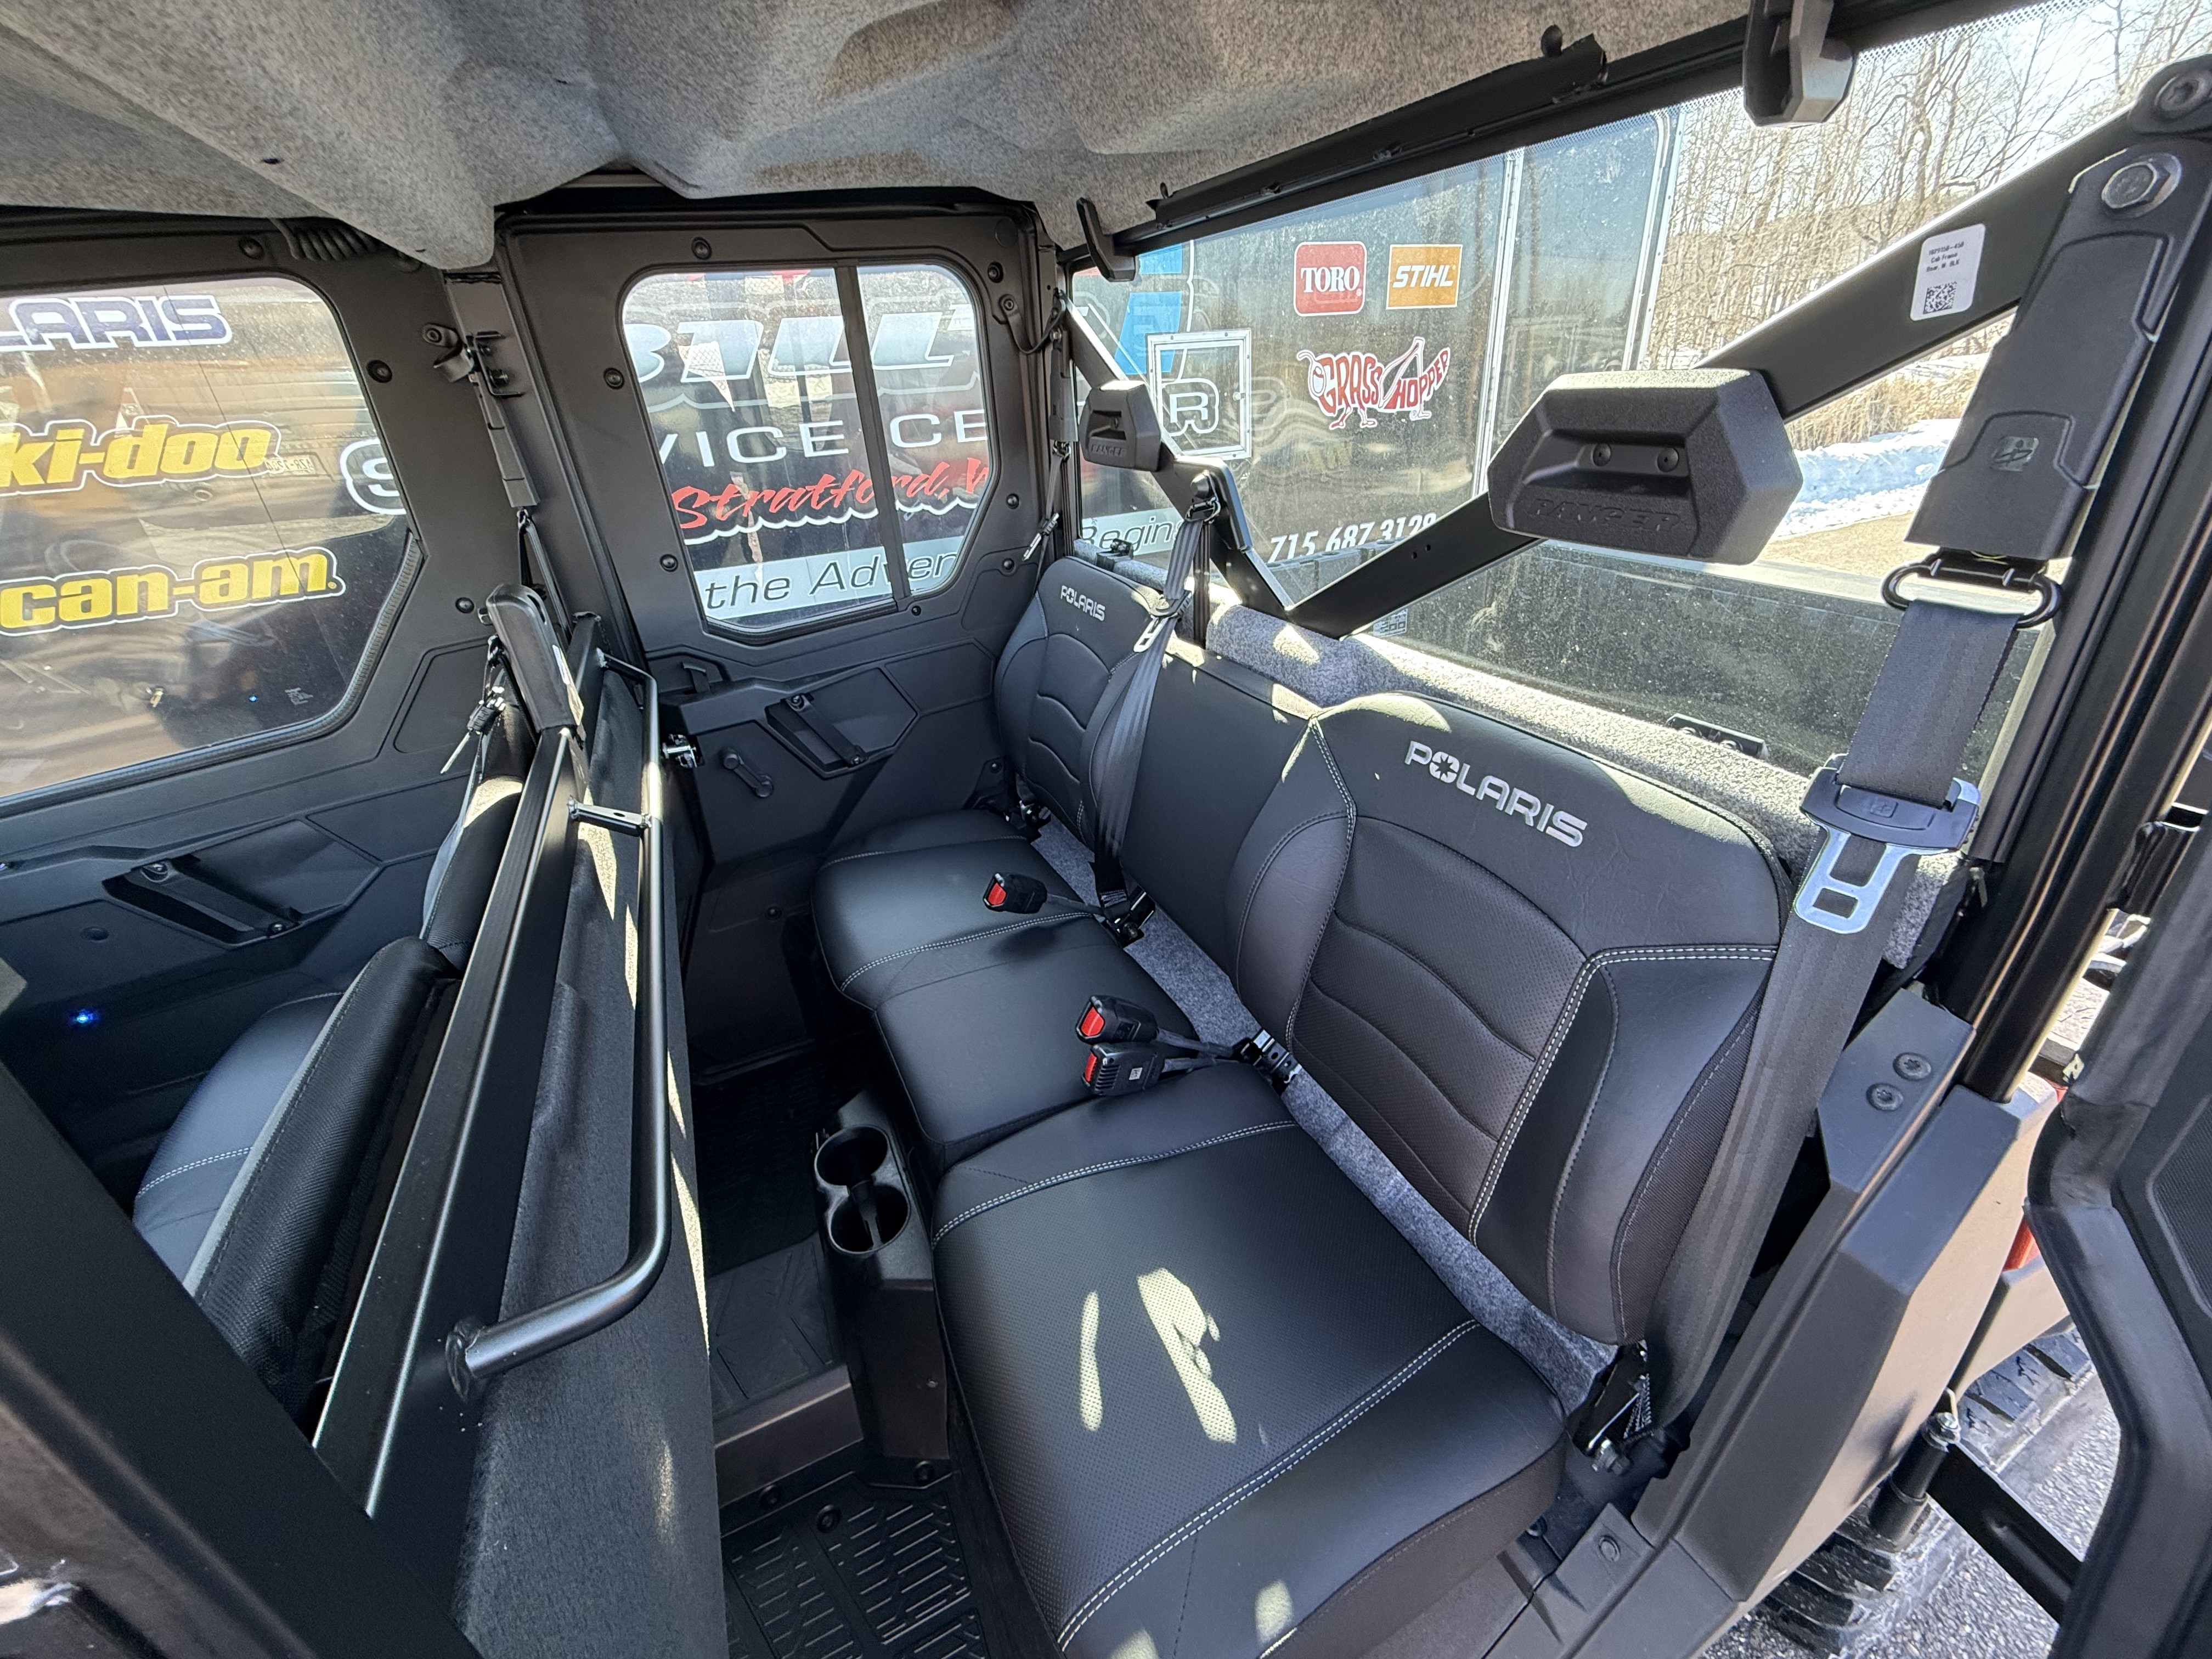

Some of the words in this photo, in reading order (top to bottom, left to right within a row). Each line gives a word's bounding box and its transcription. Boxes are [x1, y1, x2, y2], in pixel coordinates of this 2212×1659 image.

[1300, 266, 1360, 293] TORO
[1392, 264, 1454, 288] STIHL
[1325, 522, 1375, 551] 687
[0, 554, 328, 628] can-am
[704, 574, 790, 610] the
[1060, 585, 1105, 622] POLARIS
[1404, 741, 1588, 848] POLARIS
